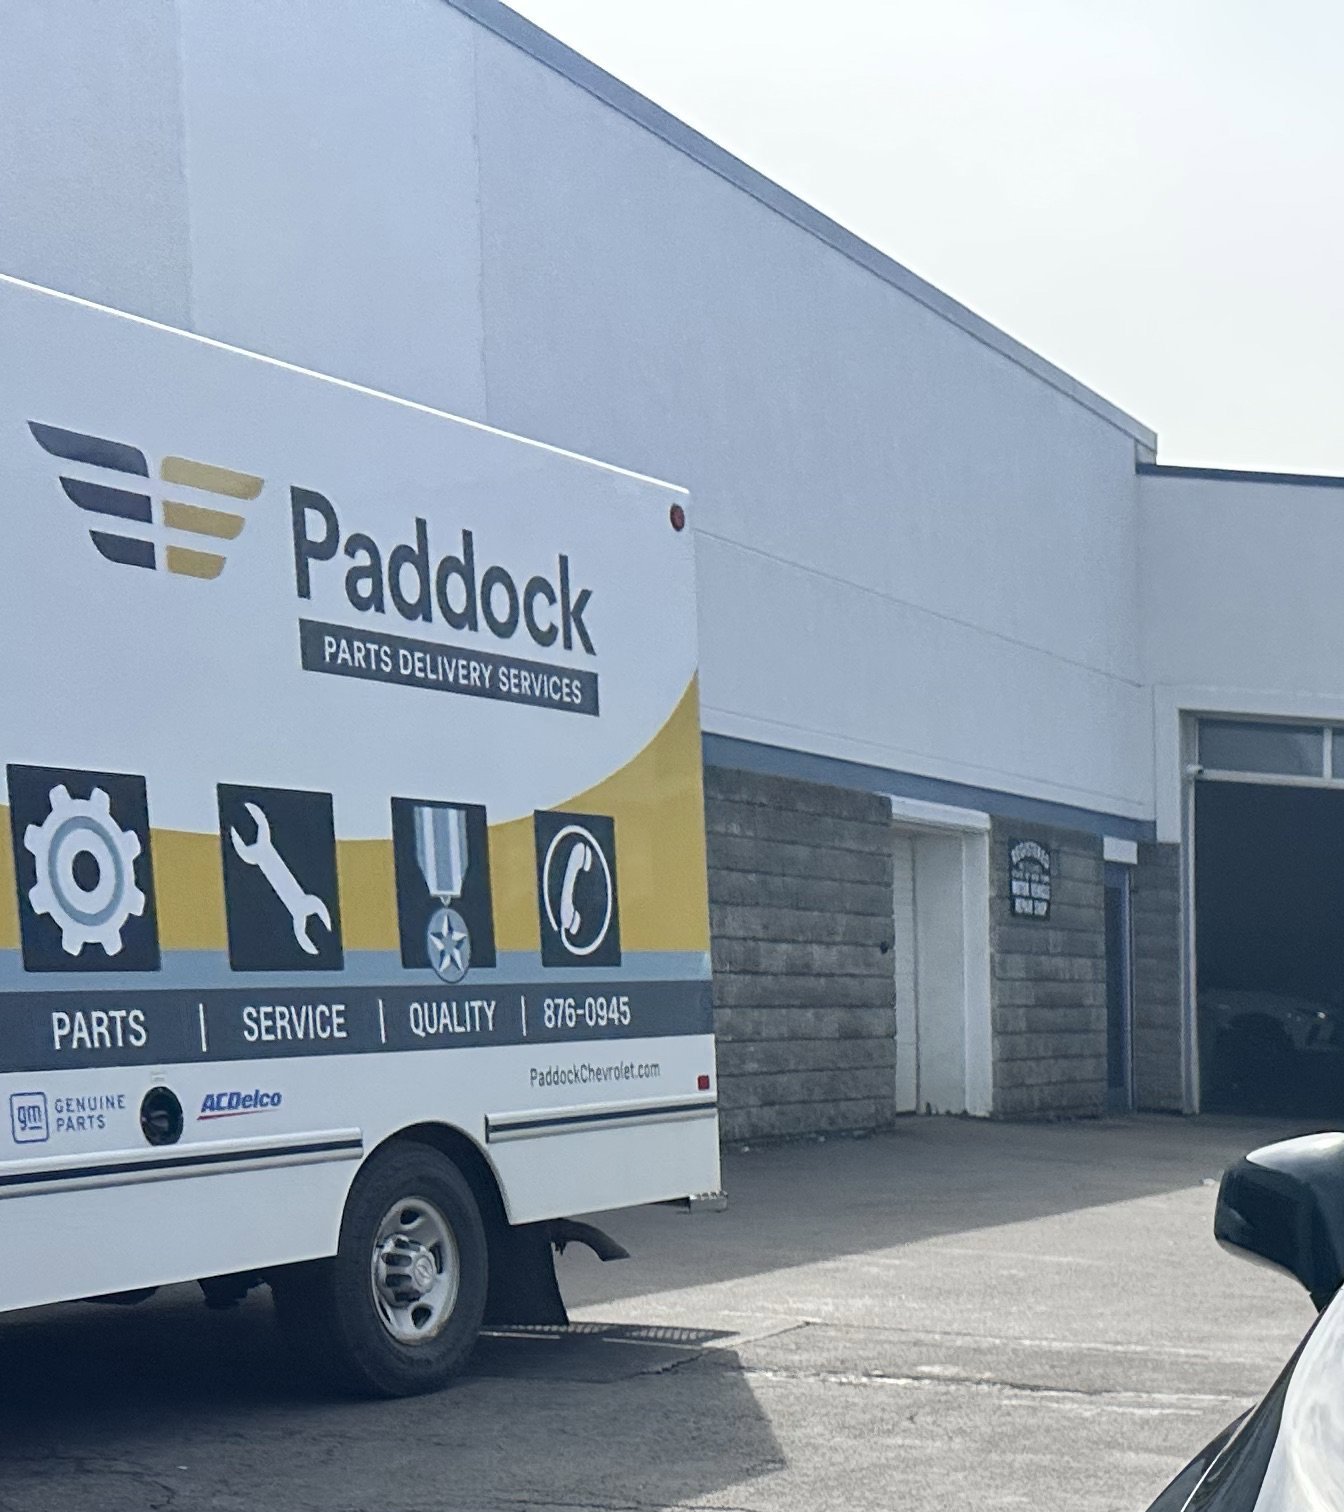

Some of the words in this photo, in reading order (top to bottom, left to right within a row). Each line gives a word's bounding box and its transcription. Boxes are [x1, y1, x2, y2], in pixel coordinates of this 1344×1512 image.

[290, 485, 597, 656] Paddock
[323, 635, 393, 673] PARTS
[399, 648, 494, 689] DELIVERY
[498, 665, 583, 705] SERVICES
[51, 1009, 148, 1050] PARTS
[243, 1003, 348, 1042] SERVICE
[408, 1000, 497, 1038] QUALITY
[543, 995, 632, 1029] 876-0945
[529, 1060, 661, 1088] PaddockChevrolet.com
[54, 1094, 126, 1114] GENUINE
[200, 1089, 282, 1113] ACDelco
[17, 1104, 43, 1131] gm
[56, 1114, 106, 1132] PARTS
